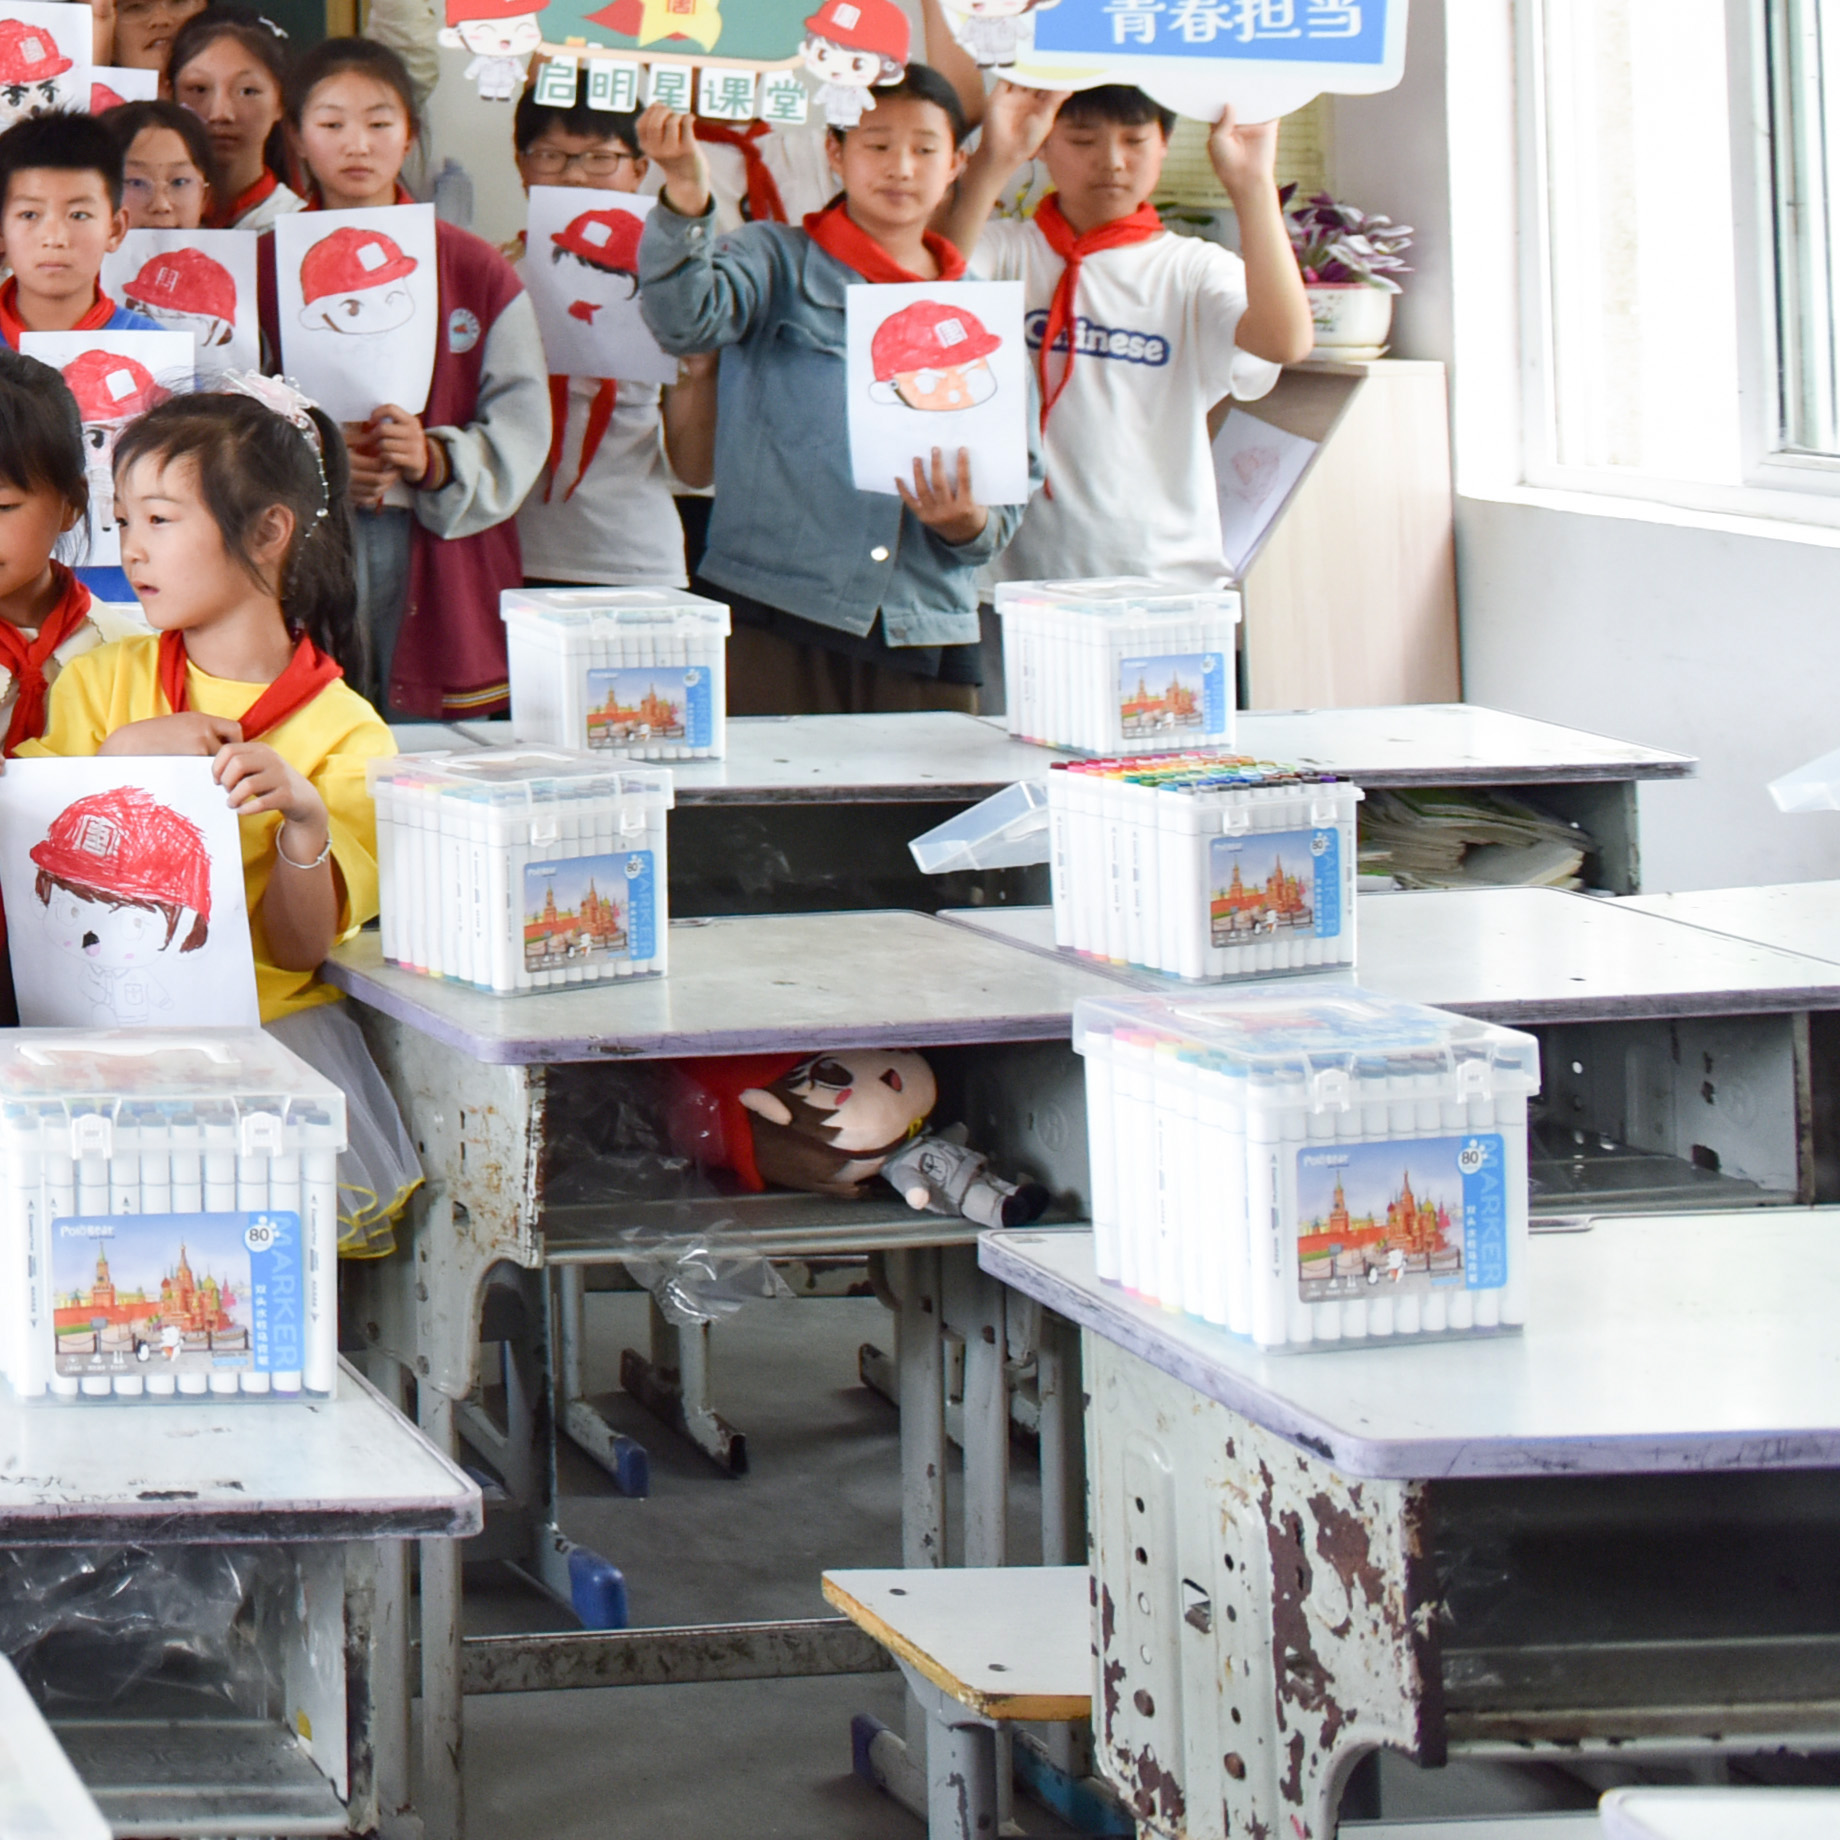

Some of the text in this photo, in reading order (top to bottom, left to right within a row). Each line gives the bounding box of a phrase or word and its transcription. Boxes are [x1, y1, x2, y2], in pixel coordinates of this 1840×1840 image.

[535, 62, 806, 124] 启明星课堂
[1025, 313, 1164, 361] Cinese
[1311, 839, 1324, 850] 80
[626, 862, 638, 872] 80
[1461, 1150, 1479, 1165] 80
[1480, 1140, 1503, 1286] MARKER
[249, 1227, 270, 1243] 80
[270, 1216, 298, 1369] MARKER
